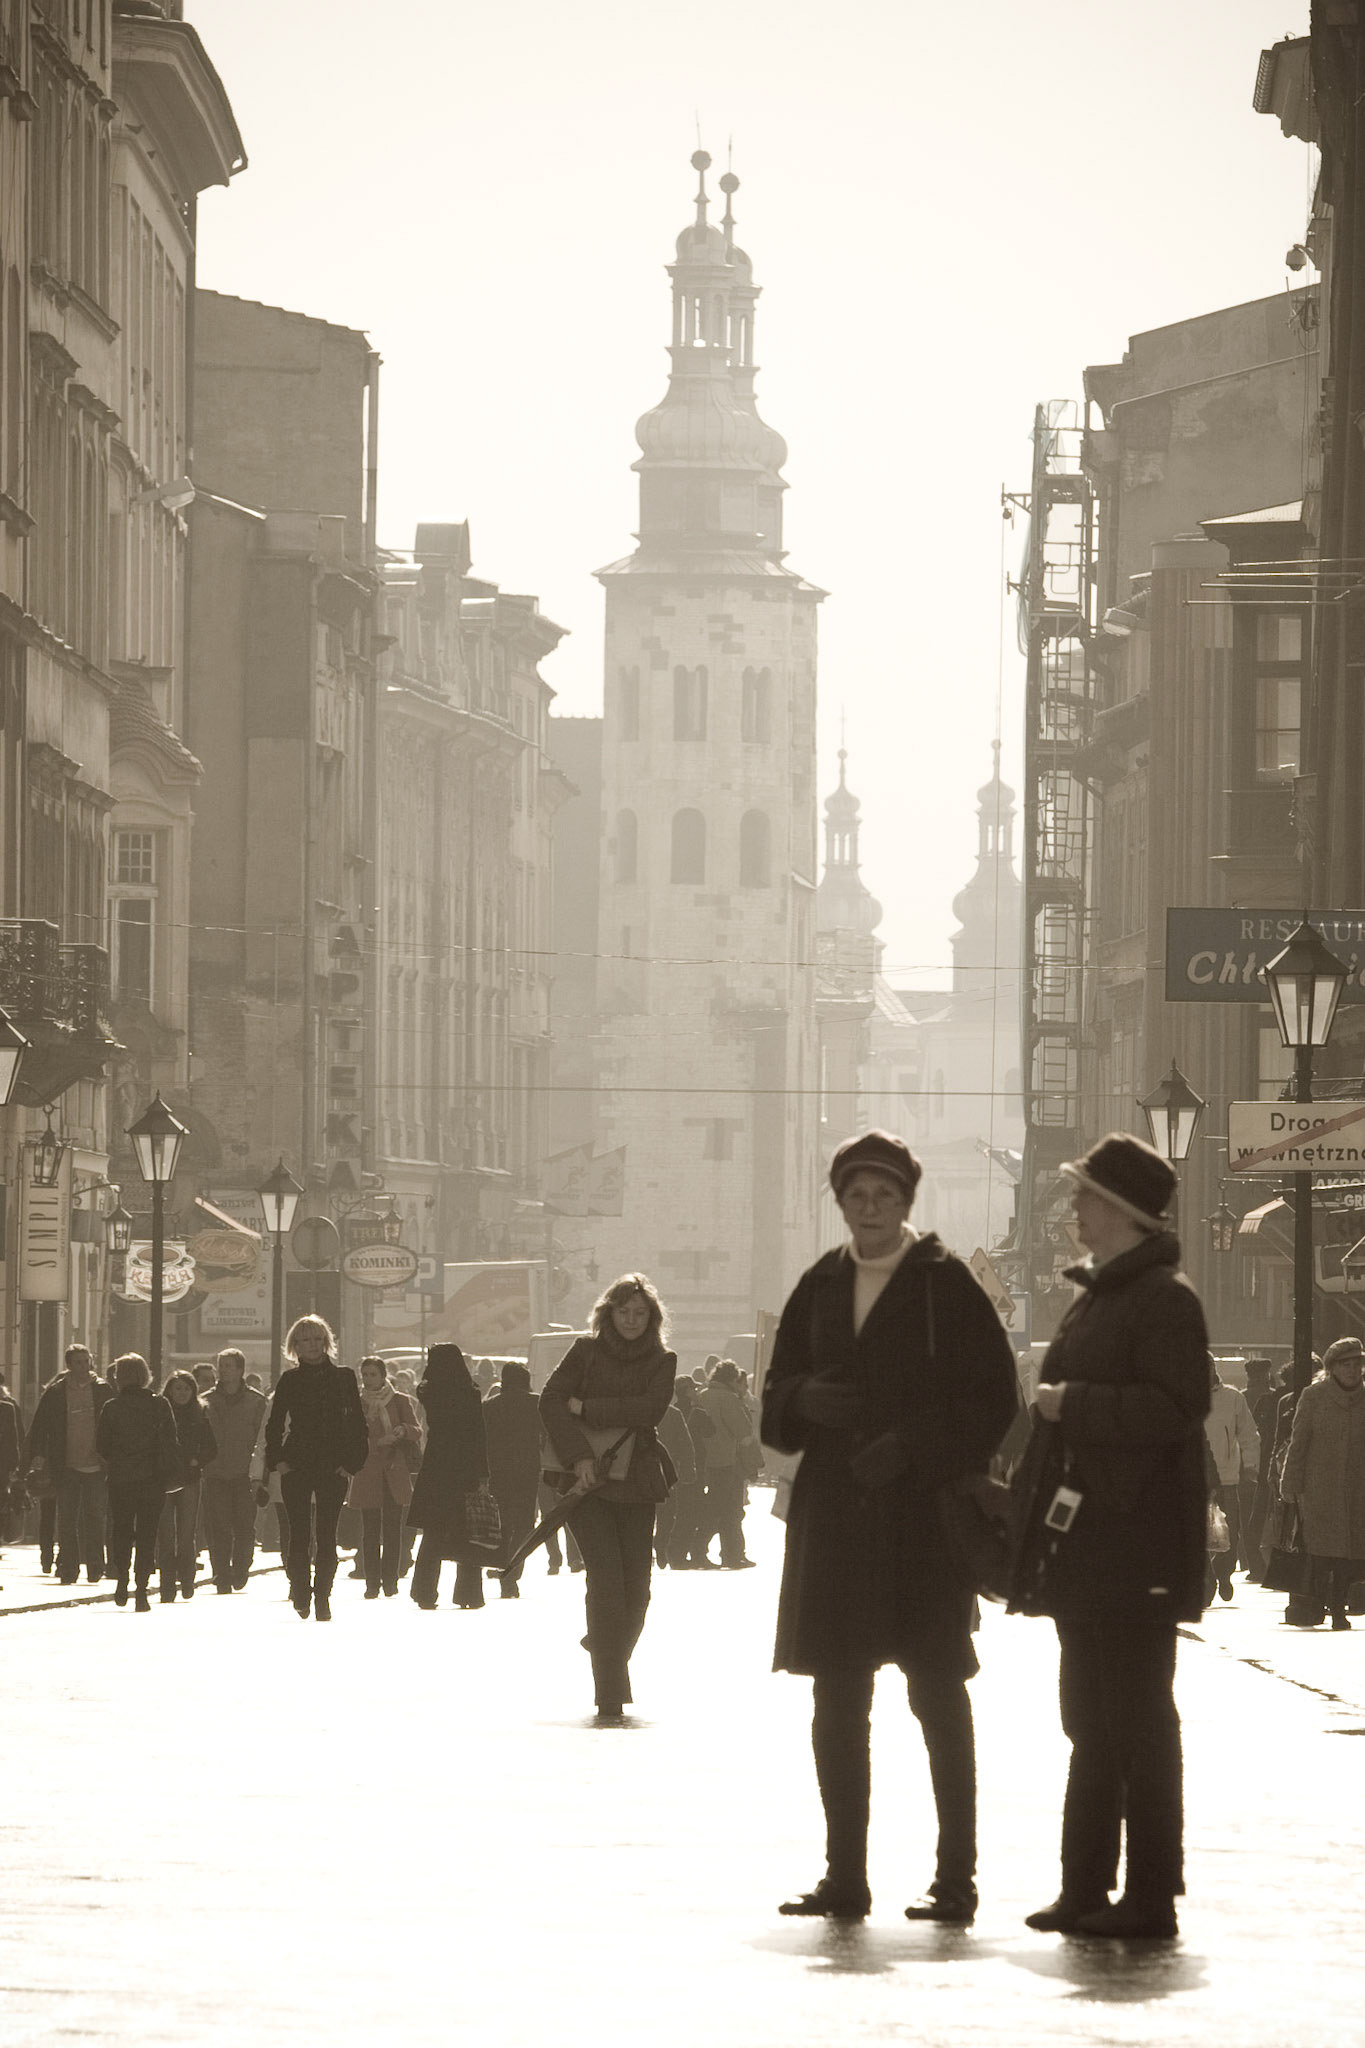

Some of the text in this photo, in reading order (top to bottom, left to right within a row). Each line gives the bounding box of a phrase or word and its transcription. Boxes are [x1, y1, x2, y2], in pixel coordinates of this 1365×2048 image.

[1344, 1194, 1365, 1207] GR
[349, 1256, 411, 1269] KOMINKI
[414, 1257, 437, 1288] P
